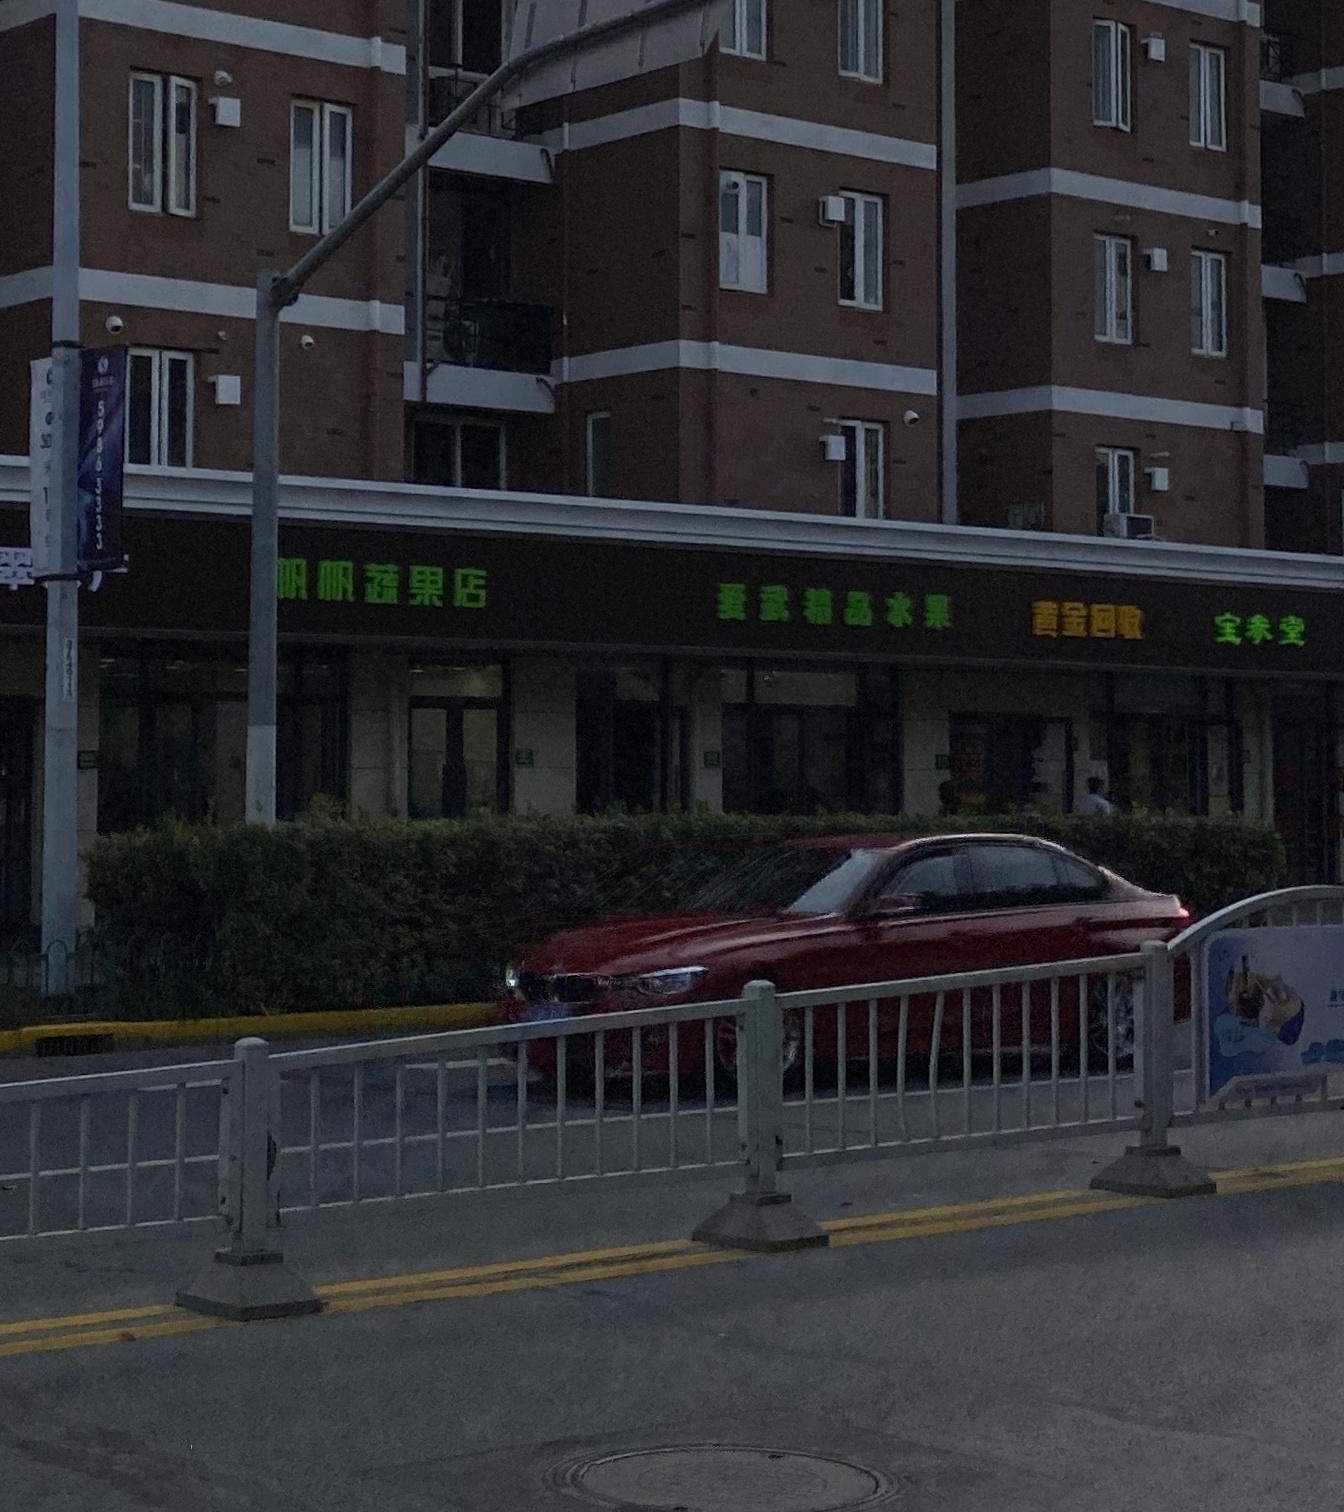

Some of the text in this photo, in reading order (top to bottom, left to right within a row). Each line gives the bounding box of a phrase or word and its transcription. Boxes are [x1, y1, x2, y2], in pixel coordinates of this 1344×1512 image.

[276, 558, 488, 609] 帆帆蔬果店
[1031, 600, 1144, 641] 黄金回收
